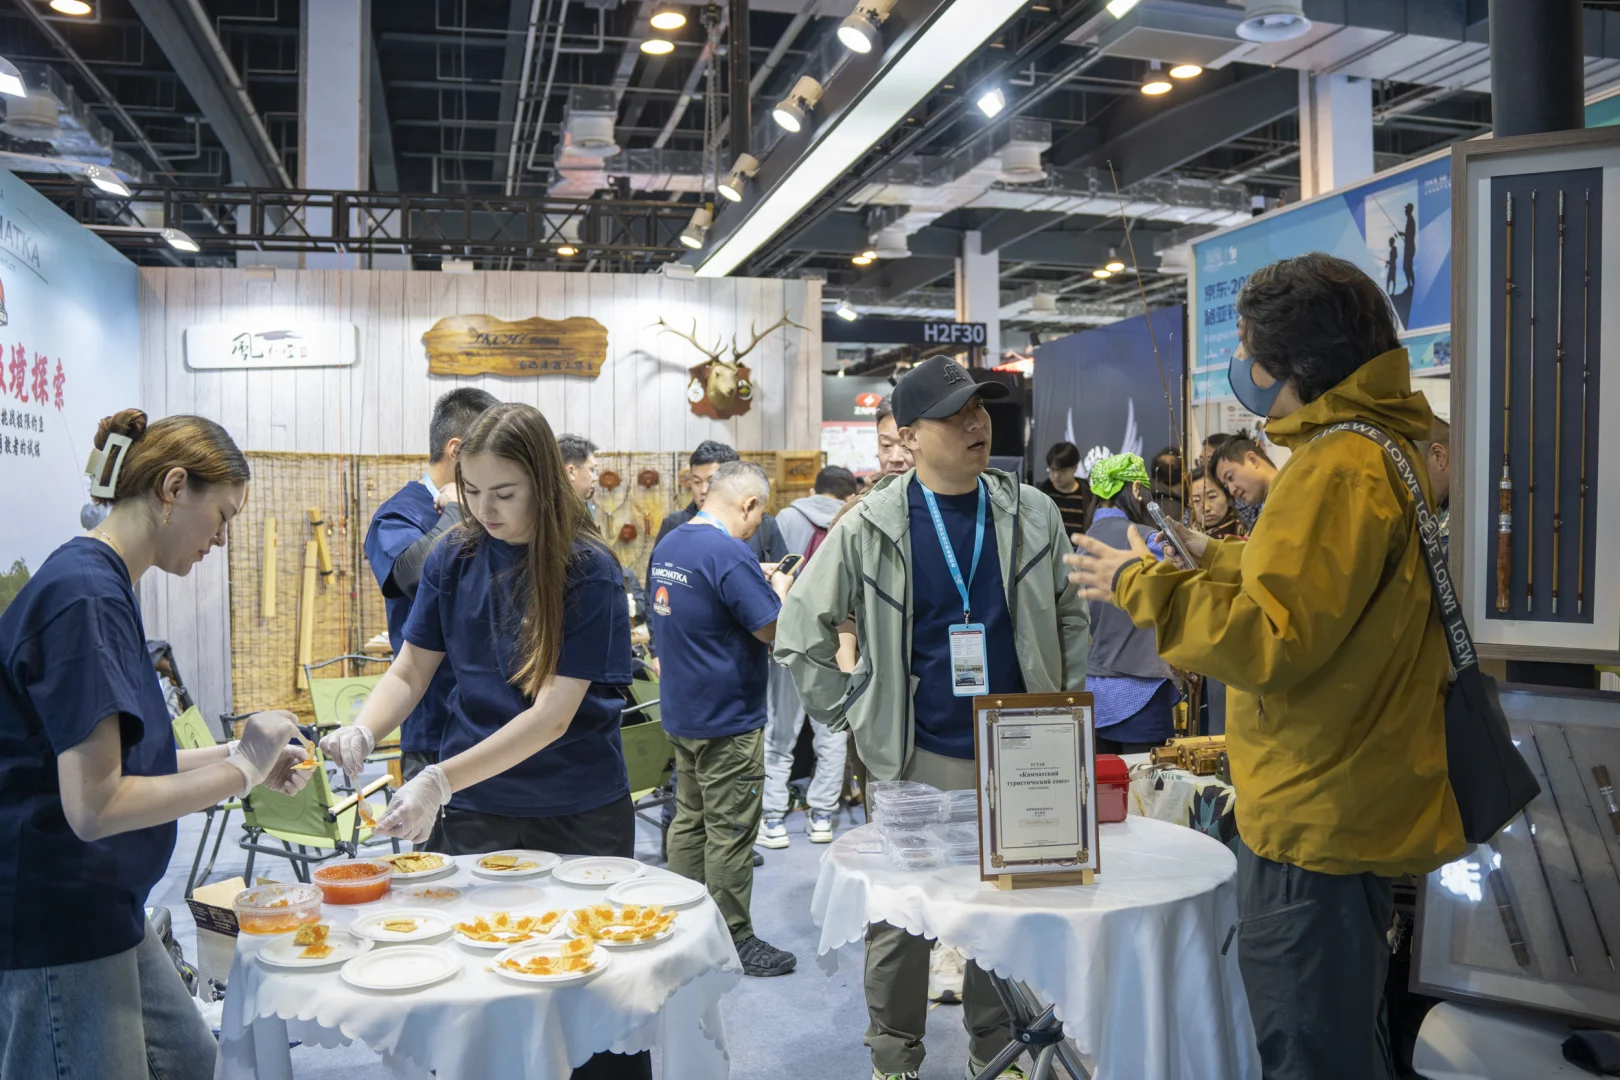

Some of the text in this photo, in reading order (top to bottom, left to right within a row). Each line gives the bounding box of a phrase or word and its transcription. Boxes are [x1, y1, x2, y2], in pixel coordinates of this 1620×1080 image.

[924, 323, 985, 343] H2F30
[1384, 439, 1420, 500] LOEWE
[1450, 620, 1475, 668] LOEW
